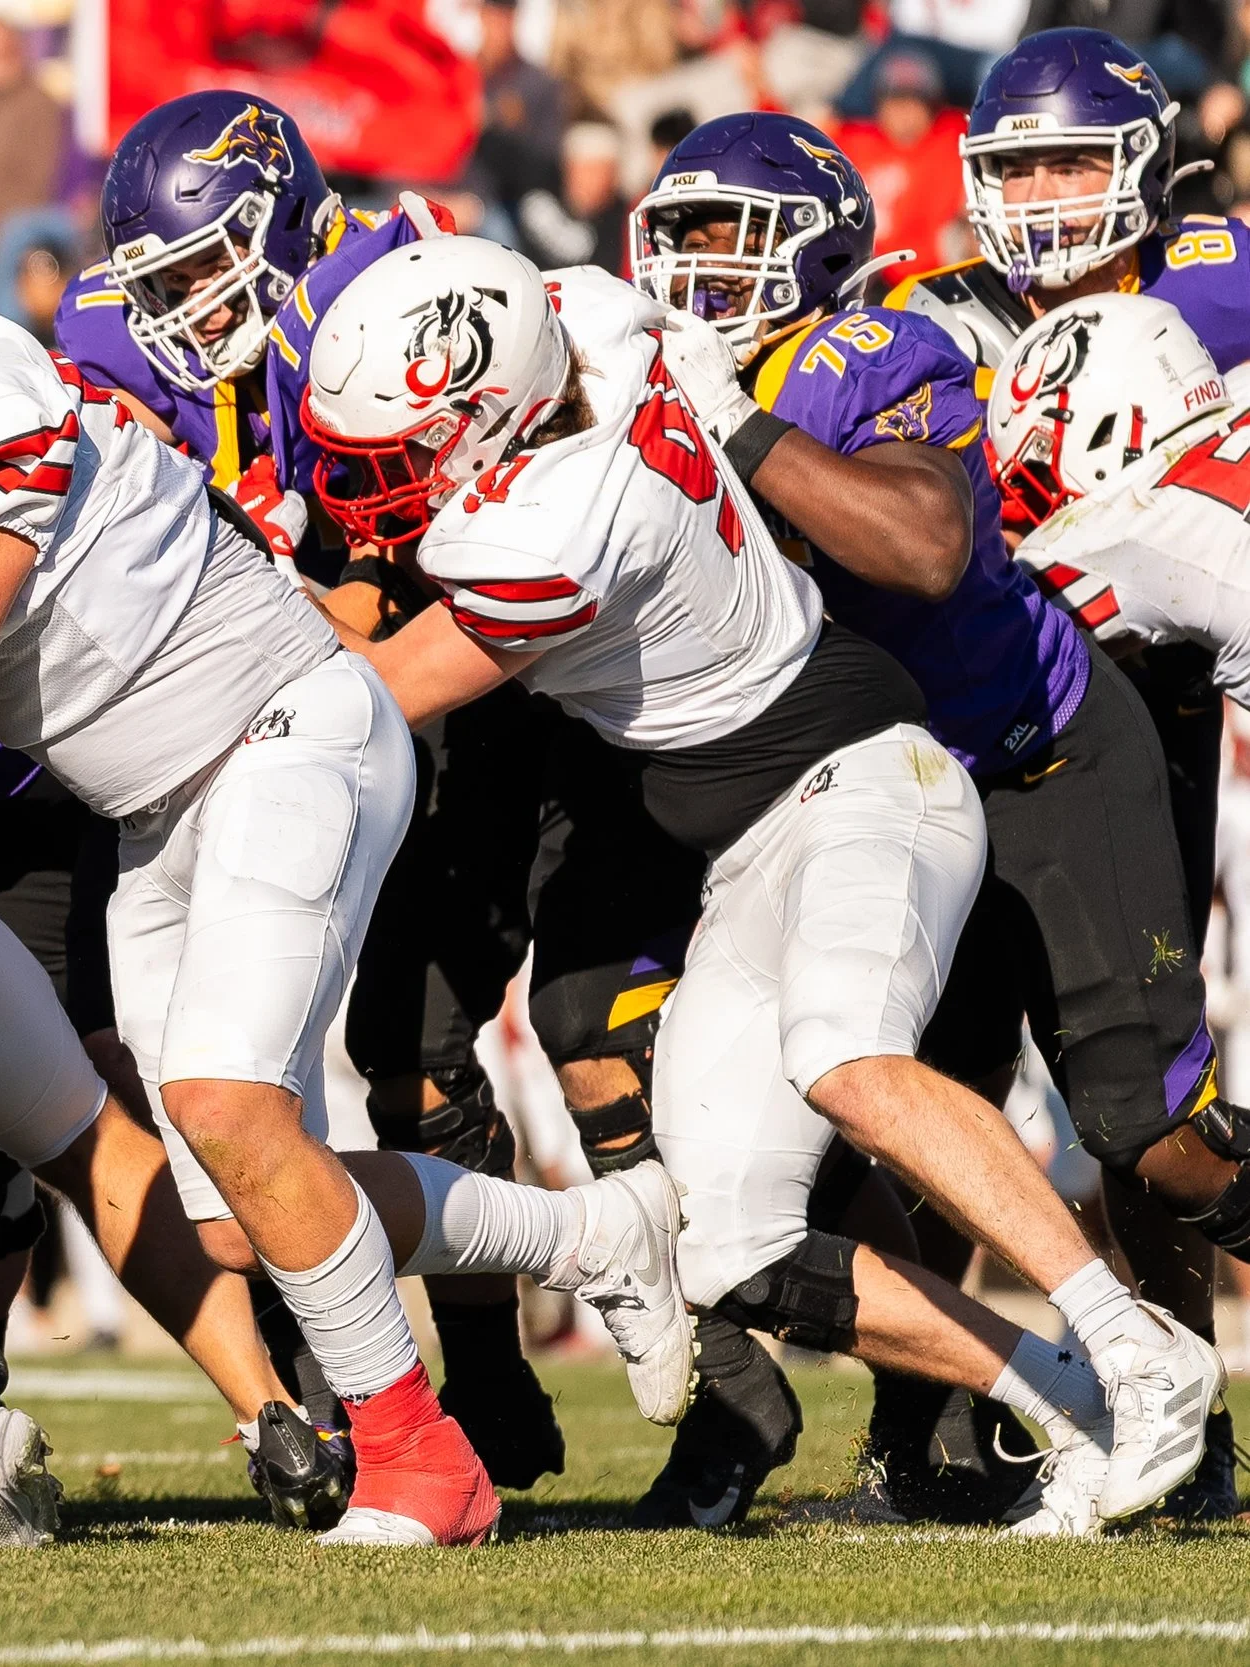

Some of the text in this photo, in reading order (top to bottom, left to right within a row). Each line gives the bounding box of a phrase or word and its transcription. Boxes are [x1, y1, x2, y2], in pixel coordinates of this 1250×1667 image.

[798, 312, 895, 379] 75
[1183, 379, 1221, 411] FIND
[1004, 723, 1030, 751] 2XL
